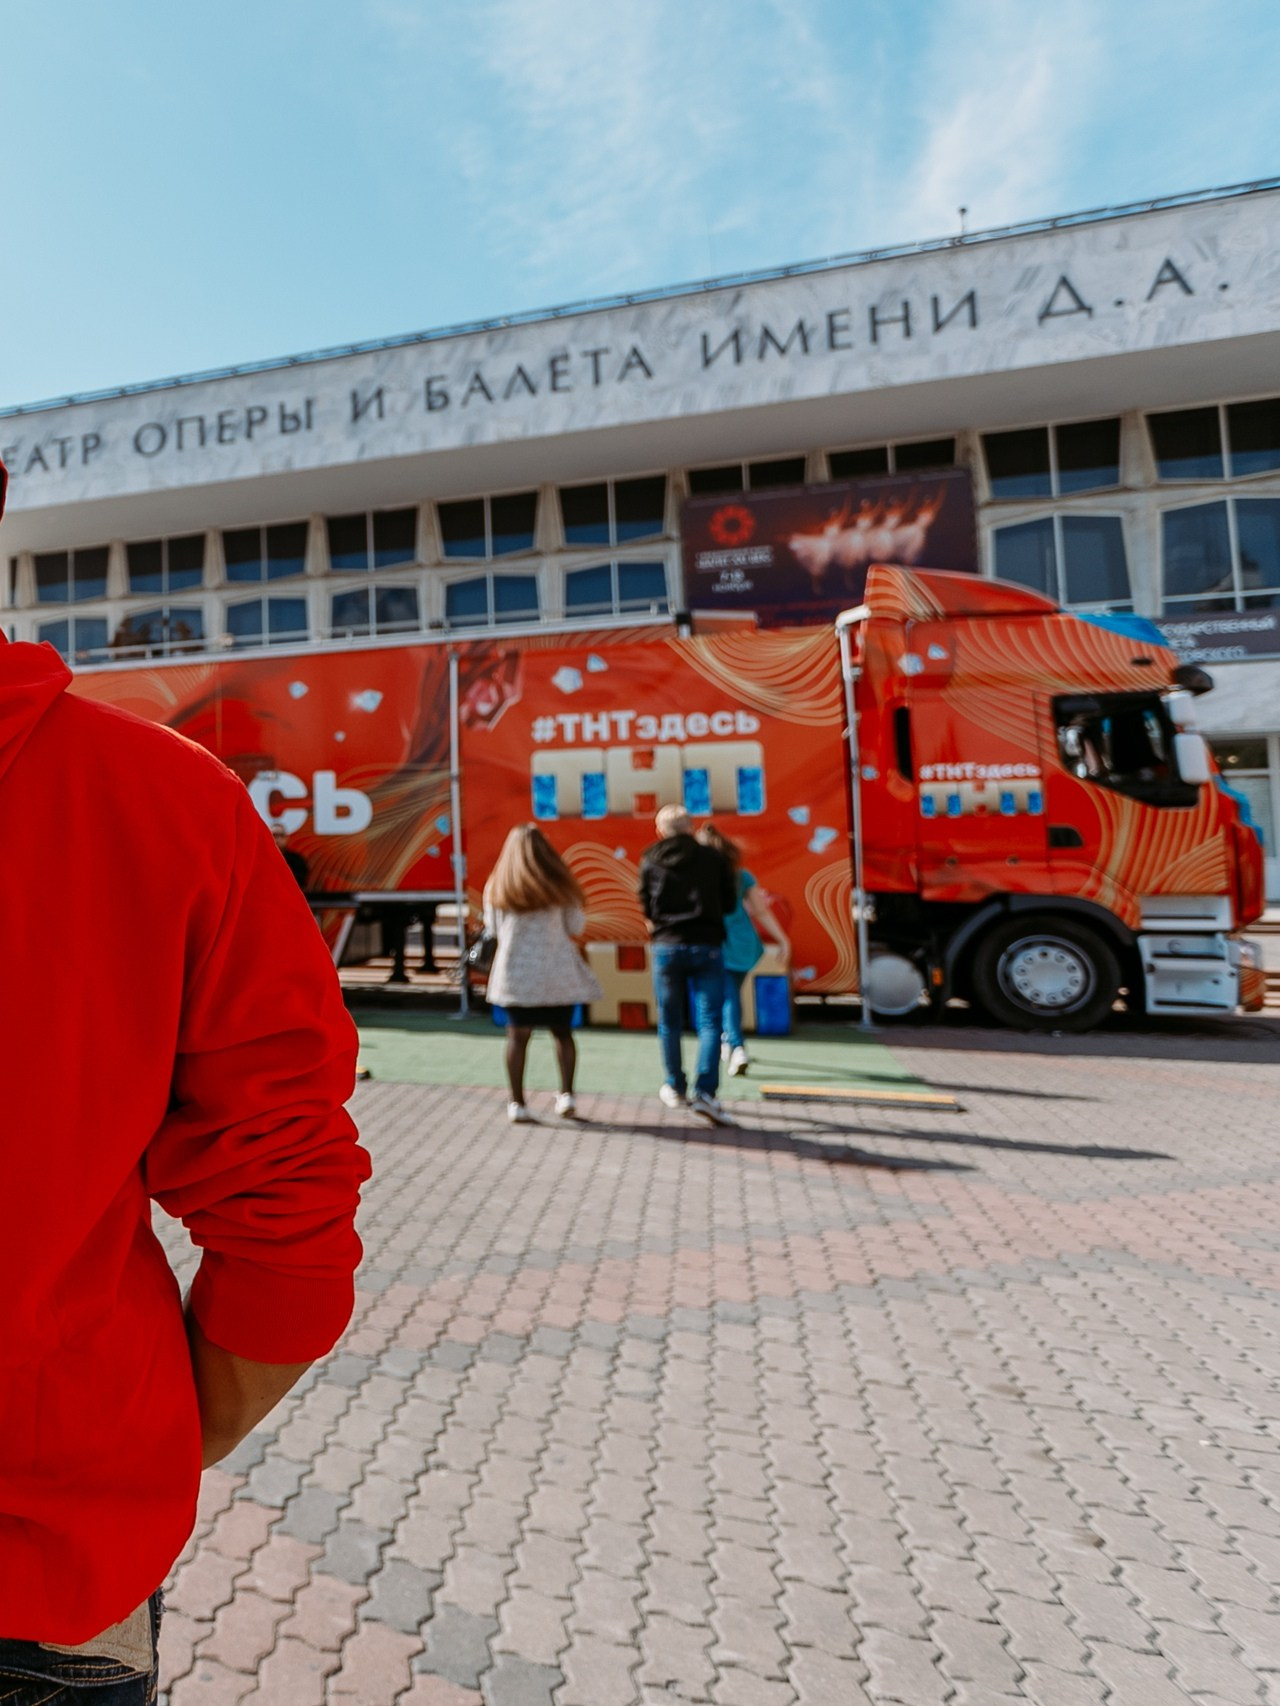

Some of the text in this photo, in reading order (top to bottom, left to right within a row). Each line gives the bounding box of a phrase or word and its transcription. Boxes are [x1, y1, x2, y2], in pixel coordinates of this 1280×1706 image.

[133, 398, 314, 458] ОПЕРЫ
[351, 386, 385, 424] И
[425, 346, 655, 412] БАЛЕТА
[699, 289, 977, 370] ИМЕНИ
[531, 710, 760, 742] #ТНТздесь
[531, 740, 766, 820] ТНТ
